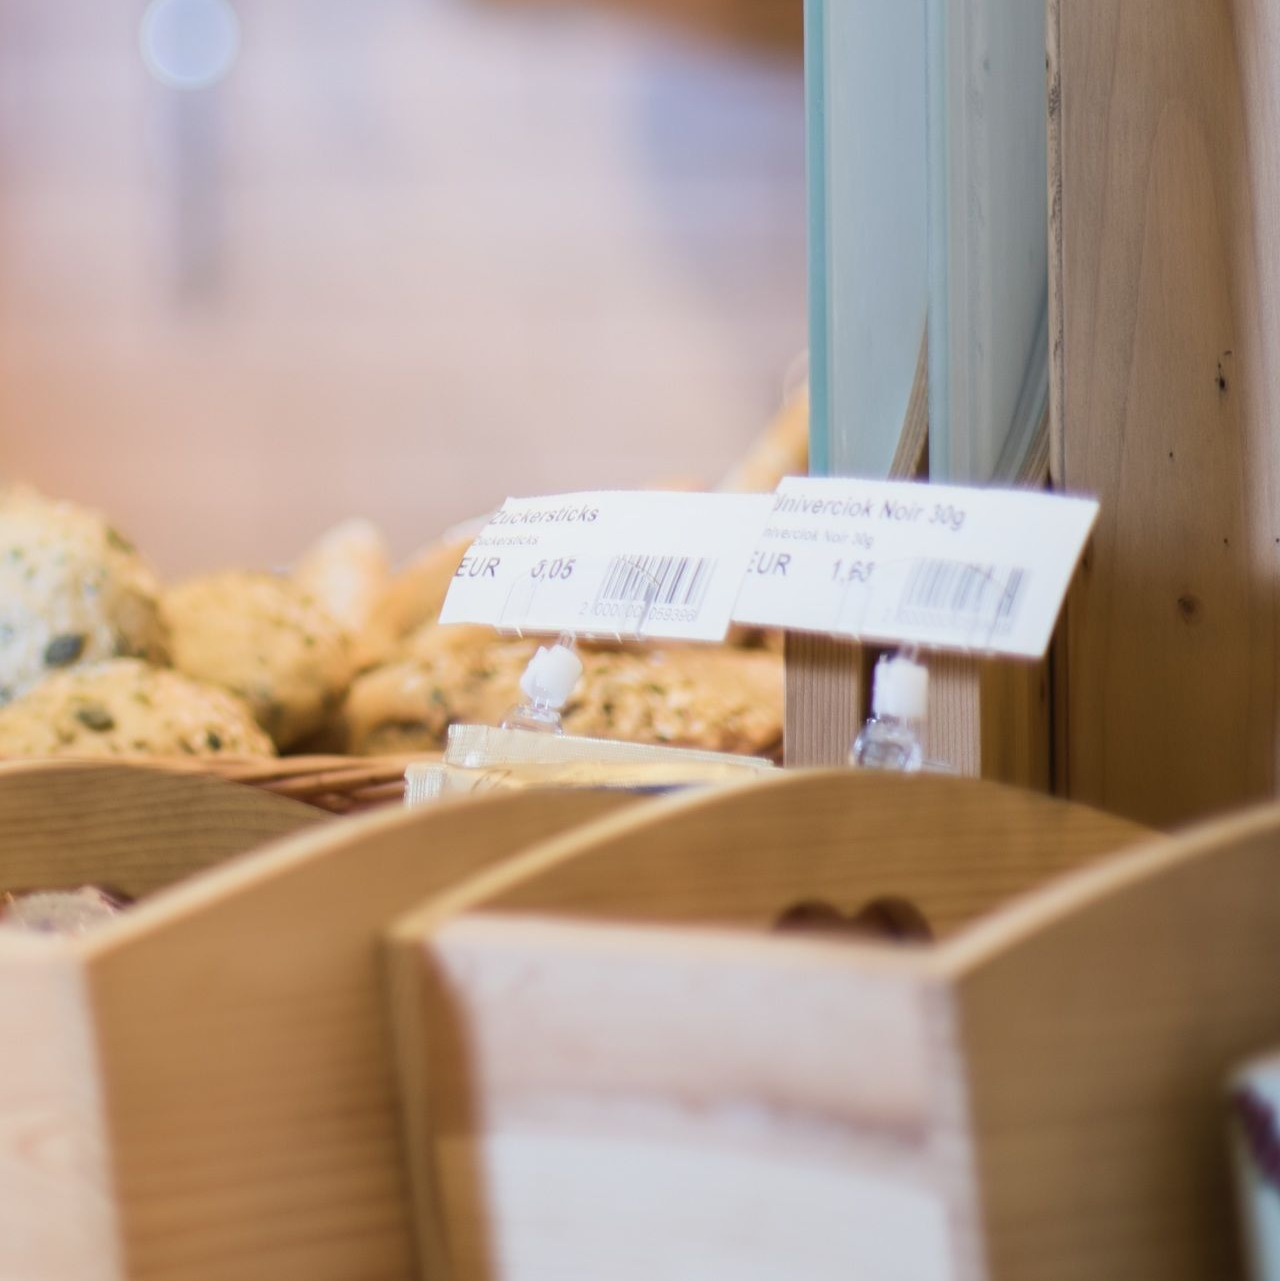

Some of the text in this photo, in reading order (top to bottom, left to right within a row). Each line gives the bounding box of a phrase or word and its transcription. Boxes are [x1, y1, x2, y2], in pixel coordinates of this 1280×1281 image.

[489, 504, 599, 525] Zuckersticks
[878, 499, 924, 522] Noir
[928, 504, 967, 532] 30g
[454, 557, 500, 577] EUR
